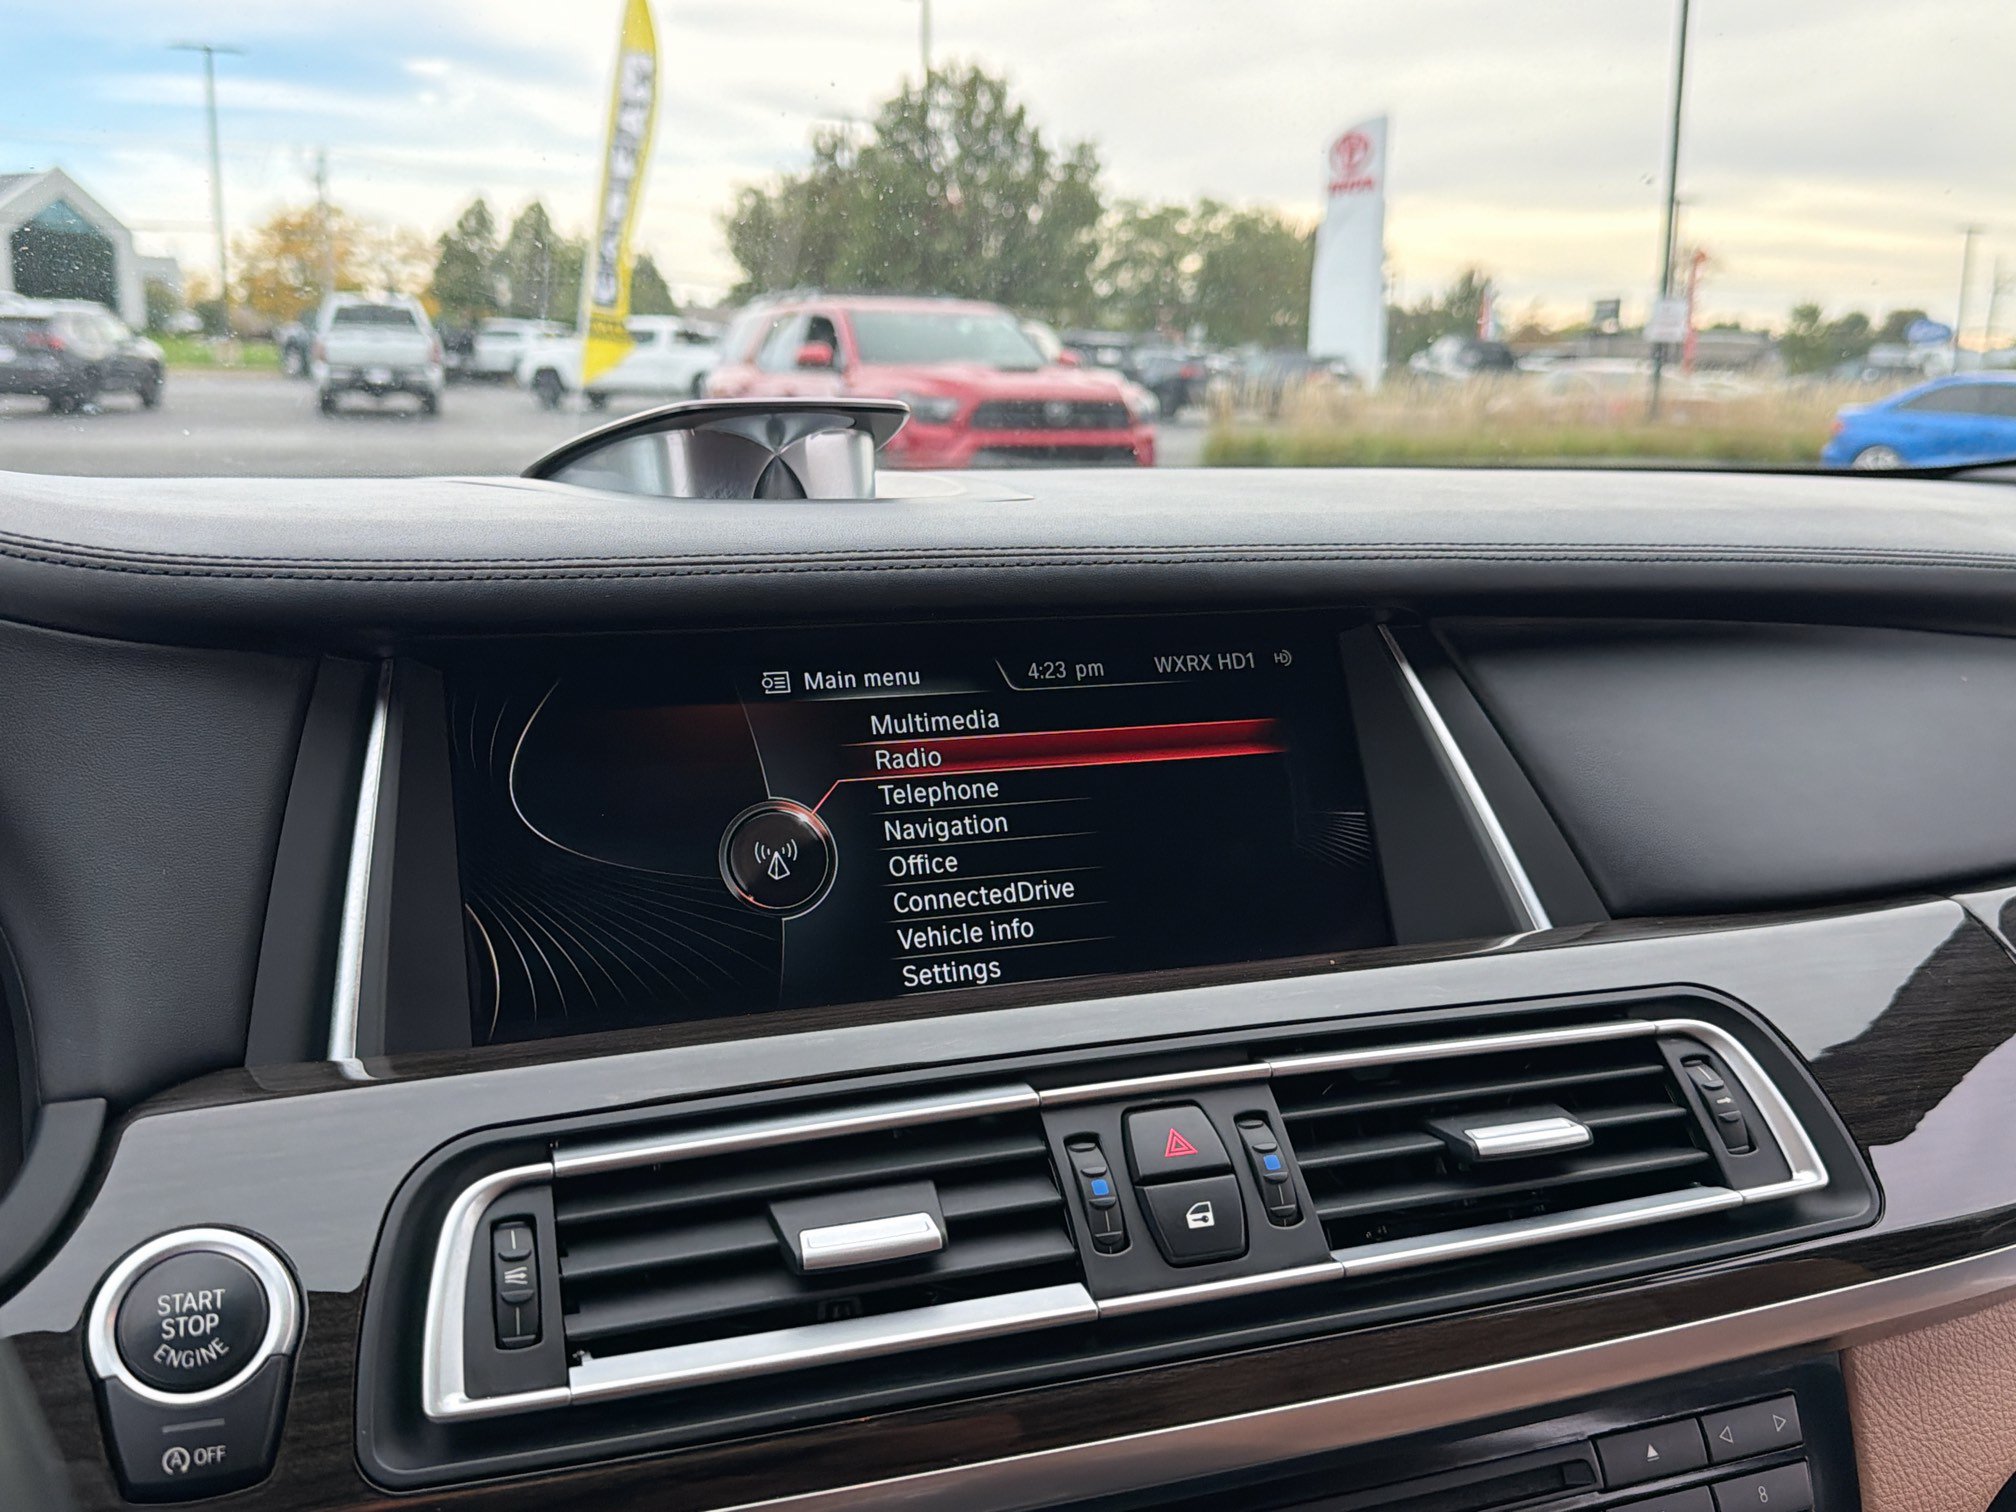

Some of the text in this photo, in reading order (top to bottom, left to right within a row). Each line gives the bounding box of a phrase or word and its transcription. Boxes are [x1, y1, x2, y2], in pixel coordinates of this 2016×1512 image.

[1027, 660, 1105, 684] 4:23 pm
[1154, 652, 1255, 673] WXRX HD1
[803, 670, 921, 692] Main menu
[871, 709, 1000, 736] Multimedia
[875, 747, 942, 770] Radio
[878, 780, 999, 807] Telephone
[884, 813, 1009, 842] Navigation
[889, 853, 958, 878] Office
[893, 879, 1076, 914] ConnectedDrive
[897, 917, 1035, 951] Vehicle info
[902, 958, 1002, 988] Settings
[157, 1288, 226, 1317] START
[161, 1313, 220, 1341] STOP
[153, 1337, 230, 1369] ENGINE
[193, 1445, 227, 1466] OFF
[1757, 1485, 1769, 1503] 8
